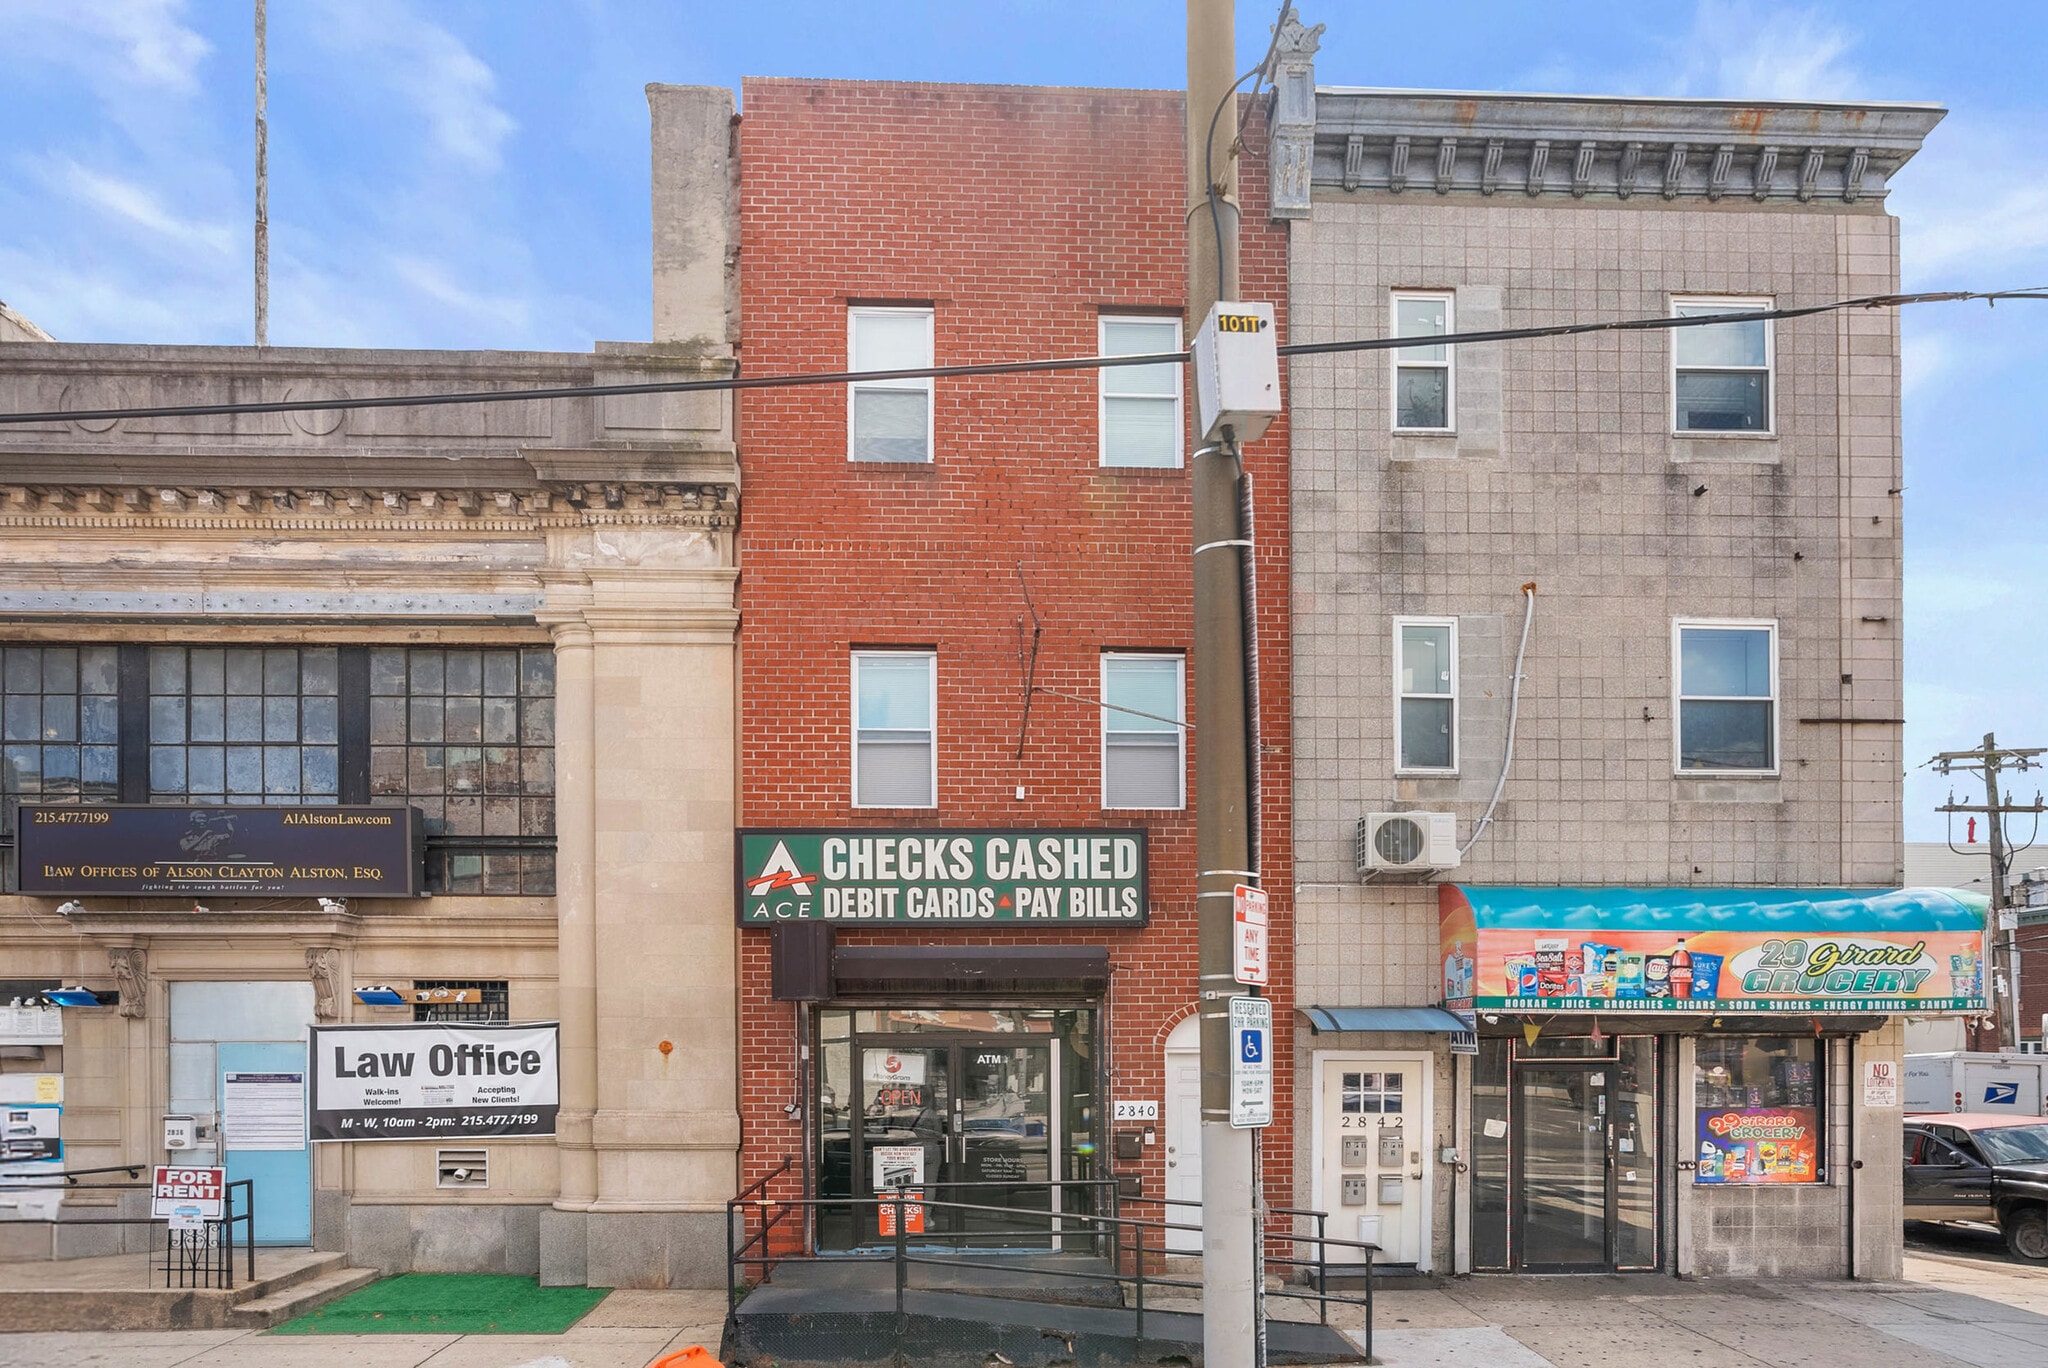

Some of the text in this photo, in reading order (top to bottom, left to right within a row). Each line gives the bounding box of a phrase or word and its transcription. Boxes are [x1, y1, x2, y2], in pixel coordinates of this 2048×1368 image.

[1220, 316, 1258, 332] 101T
[35, 812, 109, 823] 215.477.7199
[283, 813, 391, 825] AlAlstonLaw.com
[823, 837, 1138, 881] CHECKS CASHED
[823, 886, 1138, 918] DEBIT CARDS PAY BILLS
[1236, 896, 1267, 914] NO PARKING
[753, 902, 811, 918] ACE
[1244, 928, 1259, 944] ANY
[1244, 946, 1260, 961] TIME
[1757, 940, 1926, 977] 29 Girard
[1540, 981, 1564, 991] Doritos
[1741, 969, 1931, 994] GROCERY
[1234, 1002, 1267, 1016] RESERVED
[1504, 999, 1548, 1009] HOOKAH
[1561, 999, 1591, 1009] JUICE
[1604, 999, 1663, 1009] GROCERIES
[1676, 1000, 1716, 1009] CIGARS
[1728, 1000, 1757, 1010] SODA
[1769, 1000, 1811, 1010] SNACKS
[1824, 1000, 1862, 1010] ENERGY
[1867, 1000, 1907, 1010] DRINKS
[1919, 1000, 1954, 1009] CANDY
[1233, 1016, 1268, 1028] 2HR PARKING
[335, 1044, 541, 1078] Law Office
[977, 1054, 1001, 1064] ATM
[1873, 1063, 1889, 1077] NO
[1866, 1077, 1895, 1087] LOITERING
[365, 1088, 399, 1096] Walk-ins
[477, 1086, 516, 1095] Accepting
[881, 1089, 921, 1106] OPEN
[363, 1098, 401, 1106] Welcome!
[490, 1095, 520, 1103] Clients!
[1118, 1105, 1155, 1117] 2840
[341, 1119, 353, 1128] M
[364, 1118, 379, 1129] W,
[383, 1117, 416, 1127] 10am
[425, 1116, 456, 1129] 2pm:
[461, 1114, 539, 1126] 215.477.7199
[1709, 1113, 1741, 1134] 29
[1731, 1126, 1805, 1139] GROCERY
[166, 1170, 213, 1184] FOR
[157, 1184, 220, 1198] RENT
